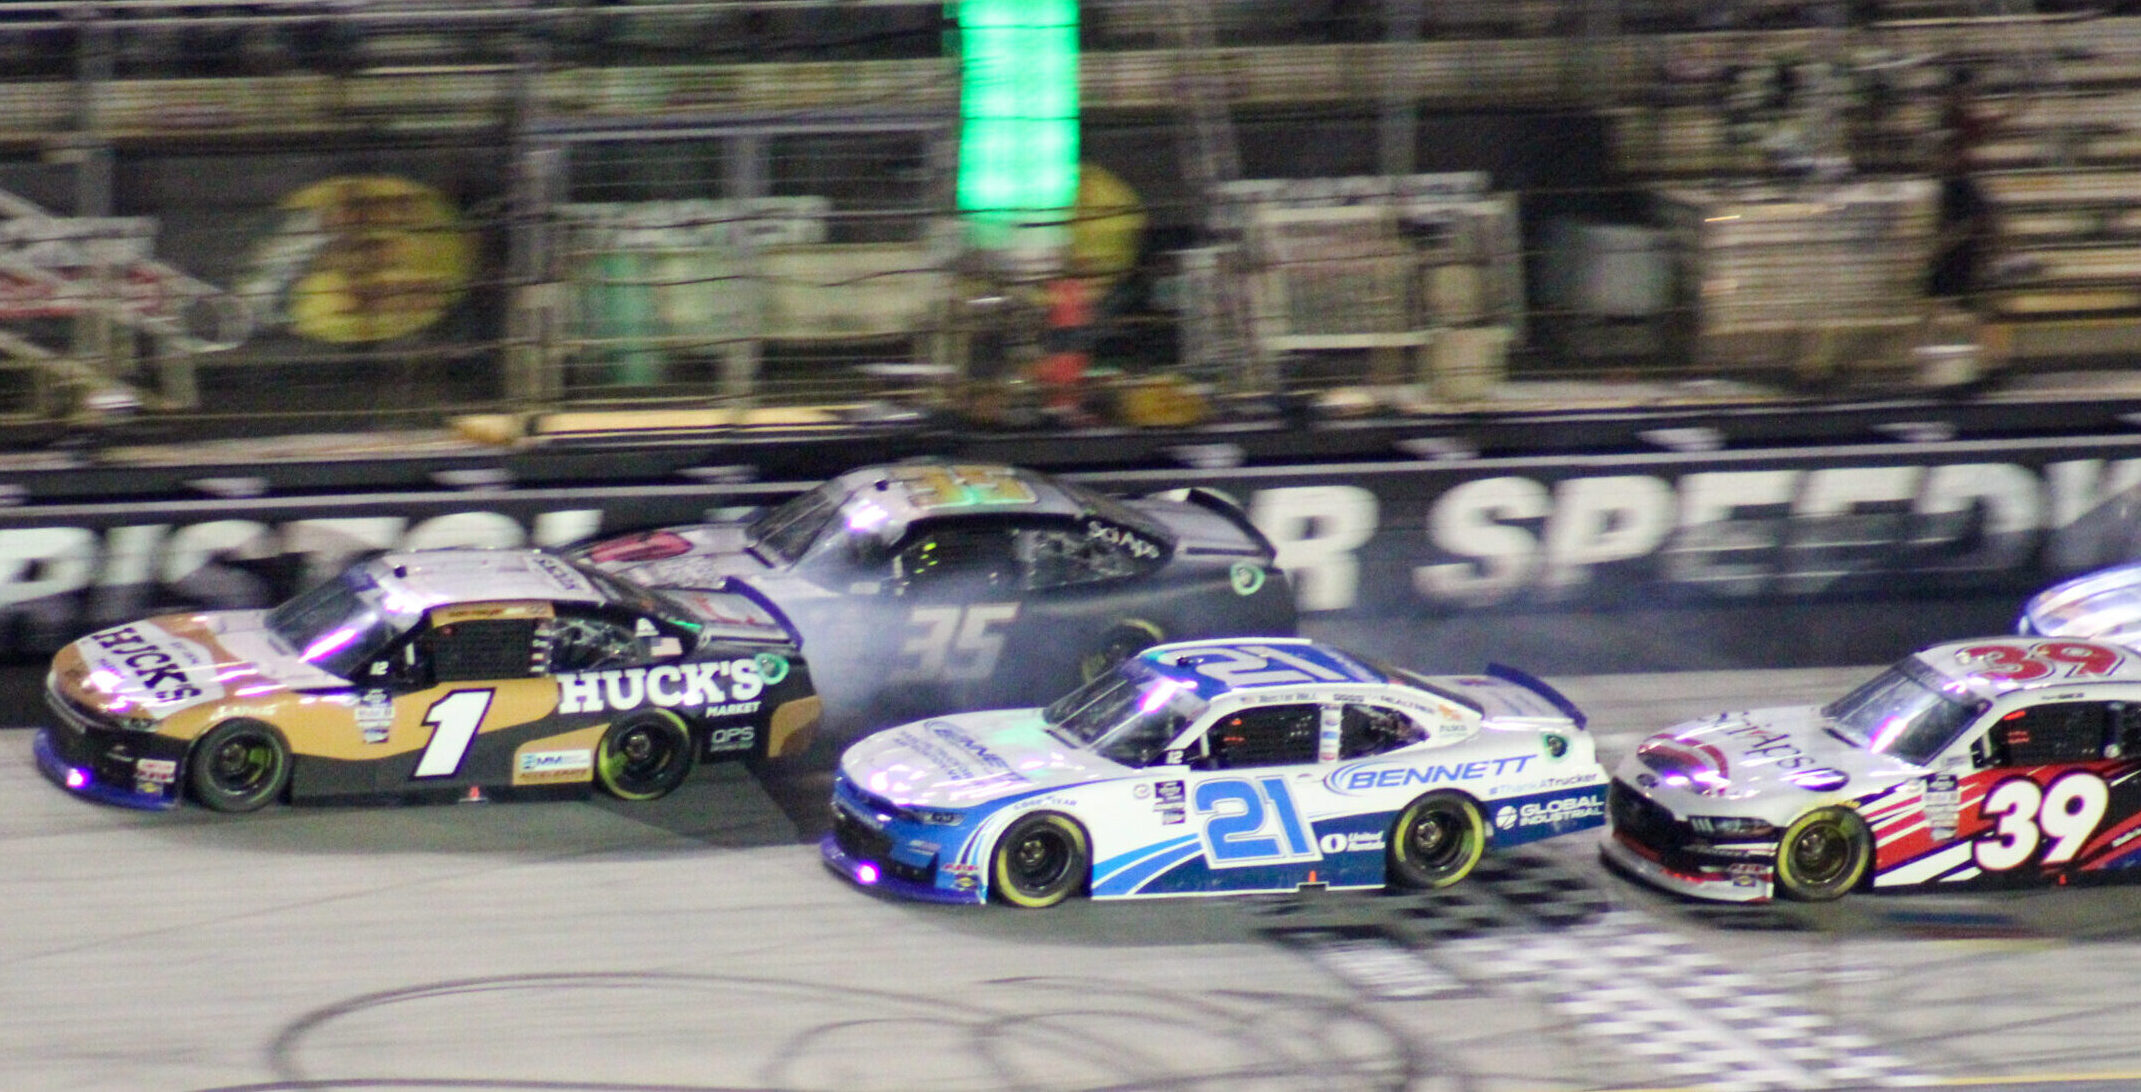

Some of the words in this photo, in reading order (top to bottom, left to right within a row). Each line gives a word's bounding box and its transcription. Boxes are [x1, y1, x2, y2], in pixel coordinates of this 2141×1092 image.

[892, 602, 1021, 681] 35
[1954, 642, 2126, 683] 39
[557, 659, 765, 715] HUCK'S
[1157, 644, 1348, 688] 21
[705, 701, 762, 718] MARKET
[413, 687, 496, 779] 1
[711, 726, 755, 745] OPS
[1347, 754, 1538, 790] BENNETT
[1193, 775, 1317, 867] 21
[1520, 795, 1605, 818] GLOBAL
[1974, 773, 2109, 871] 39
